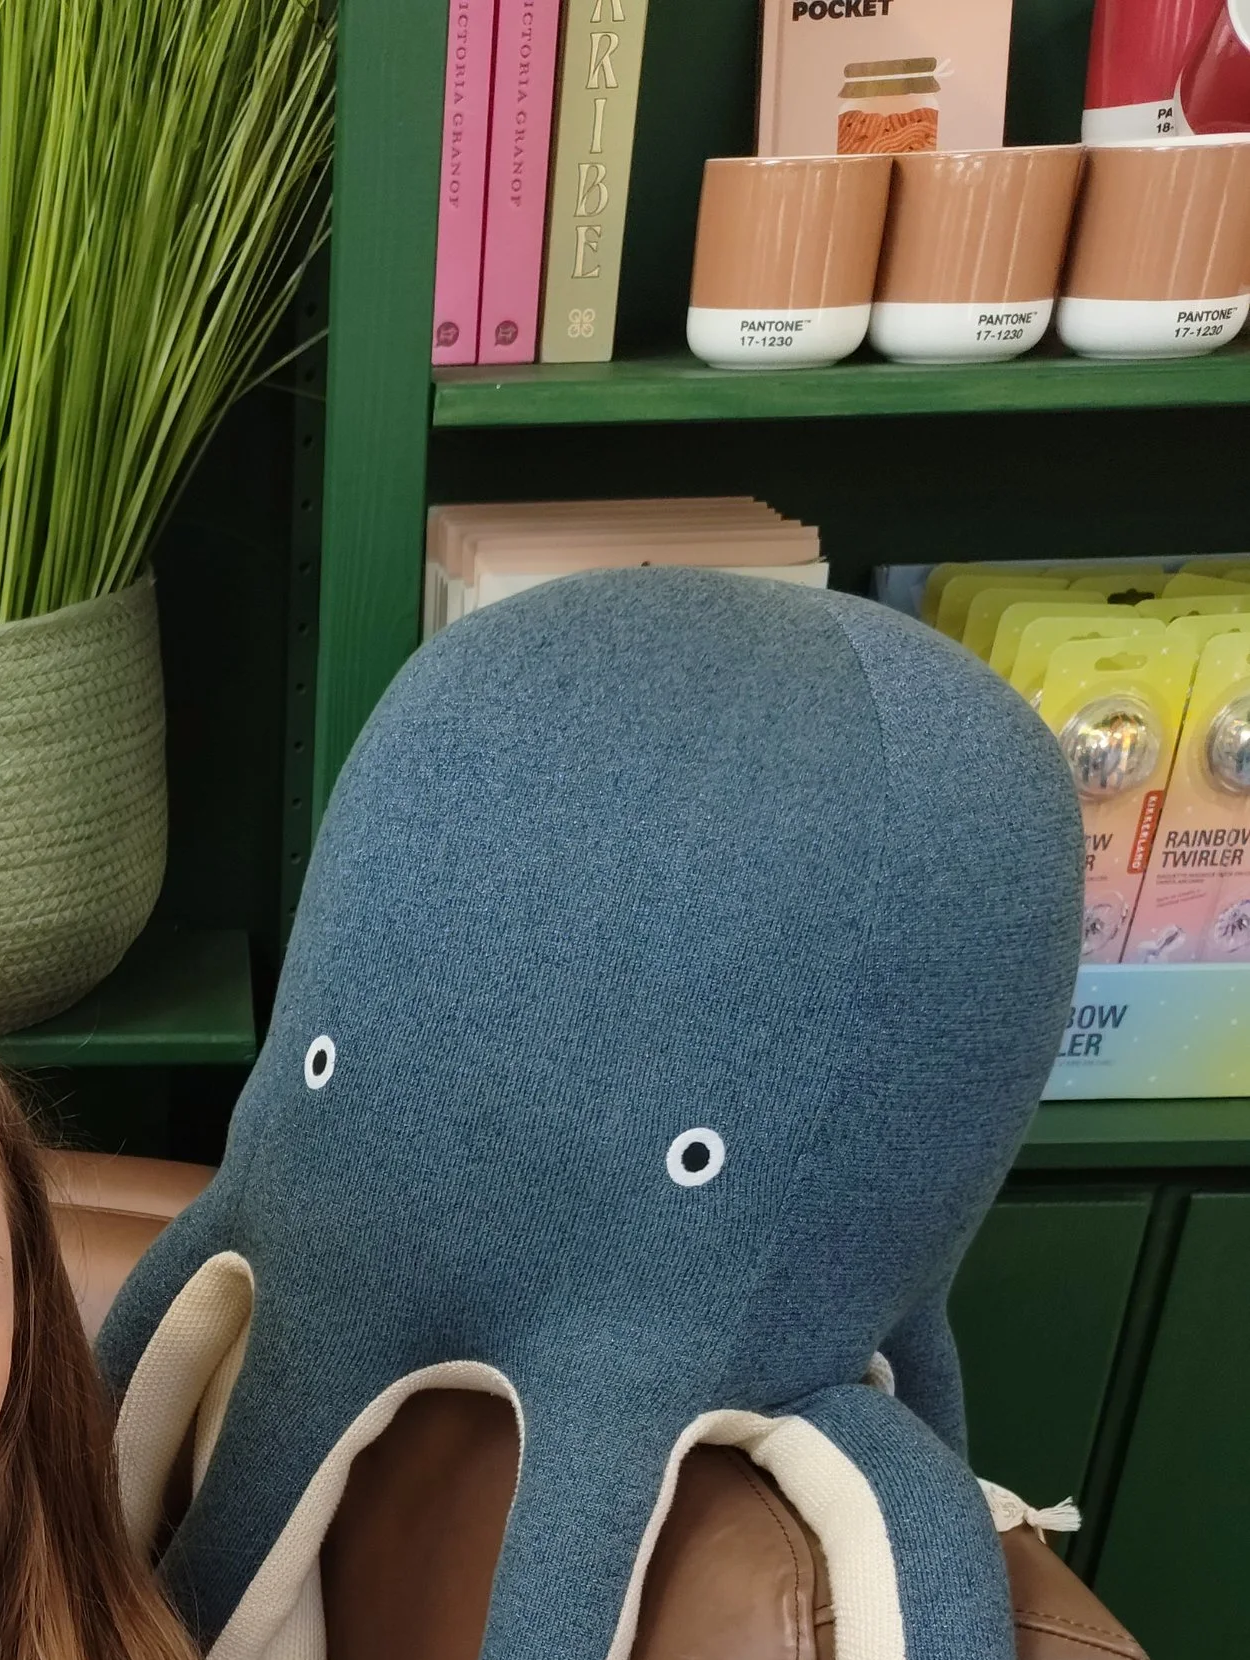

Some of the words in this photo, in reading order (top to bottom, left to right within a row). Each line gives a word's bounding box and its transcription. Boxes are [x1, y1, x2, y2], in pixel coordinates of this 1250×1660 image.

[792, 0, 894, 21] POCKET
[449, 113, 464, 208] GRANOF
[510, 111, 527, 208] GRANOF
[976, 328, 1024, 342] 17-1230
[1174, 324, 1224, 338] 17-1230
[740, 335, 794, 347] 17-1230
[1162, 849, 1244, 868] TWIRLER
